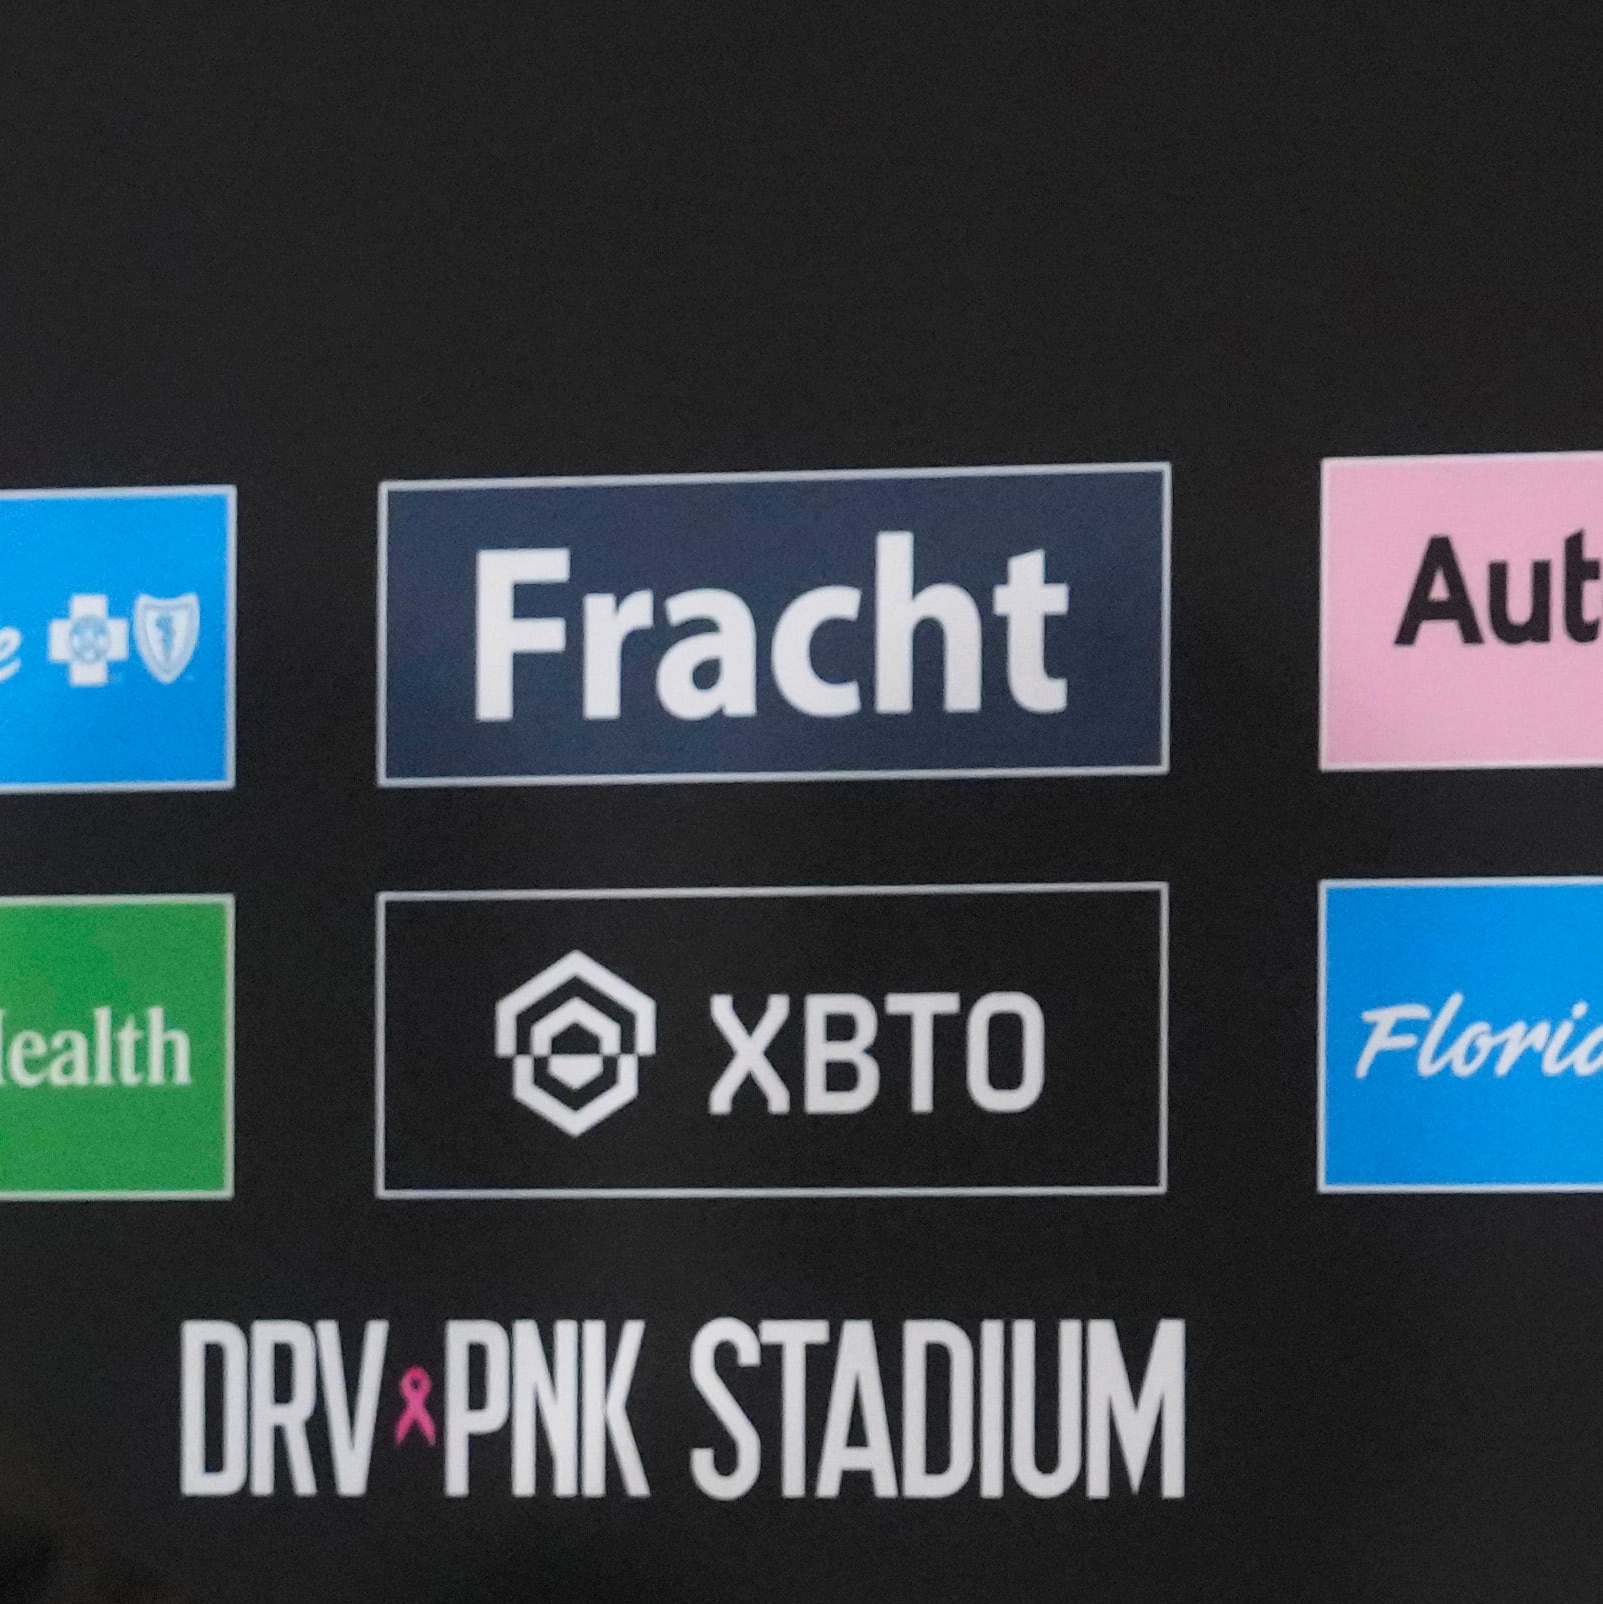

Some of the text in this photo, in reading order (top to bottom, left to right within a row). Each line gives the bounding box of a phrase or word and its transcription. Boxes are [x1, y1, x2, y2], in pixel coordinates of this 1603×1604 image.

[475, 530, 1070, 722] Fracht
[708, 990, 1046, 1116] XBTO
[180, 1316, 1186, 1501] DRV PNK STADIUM
